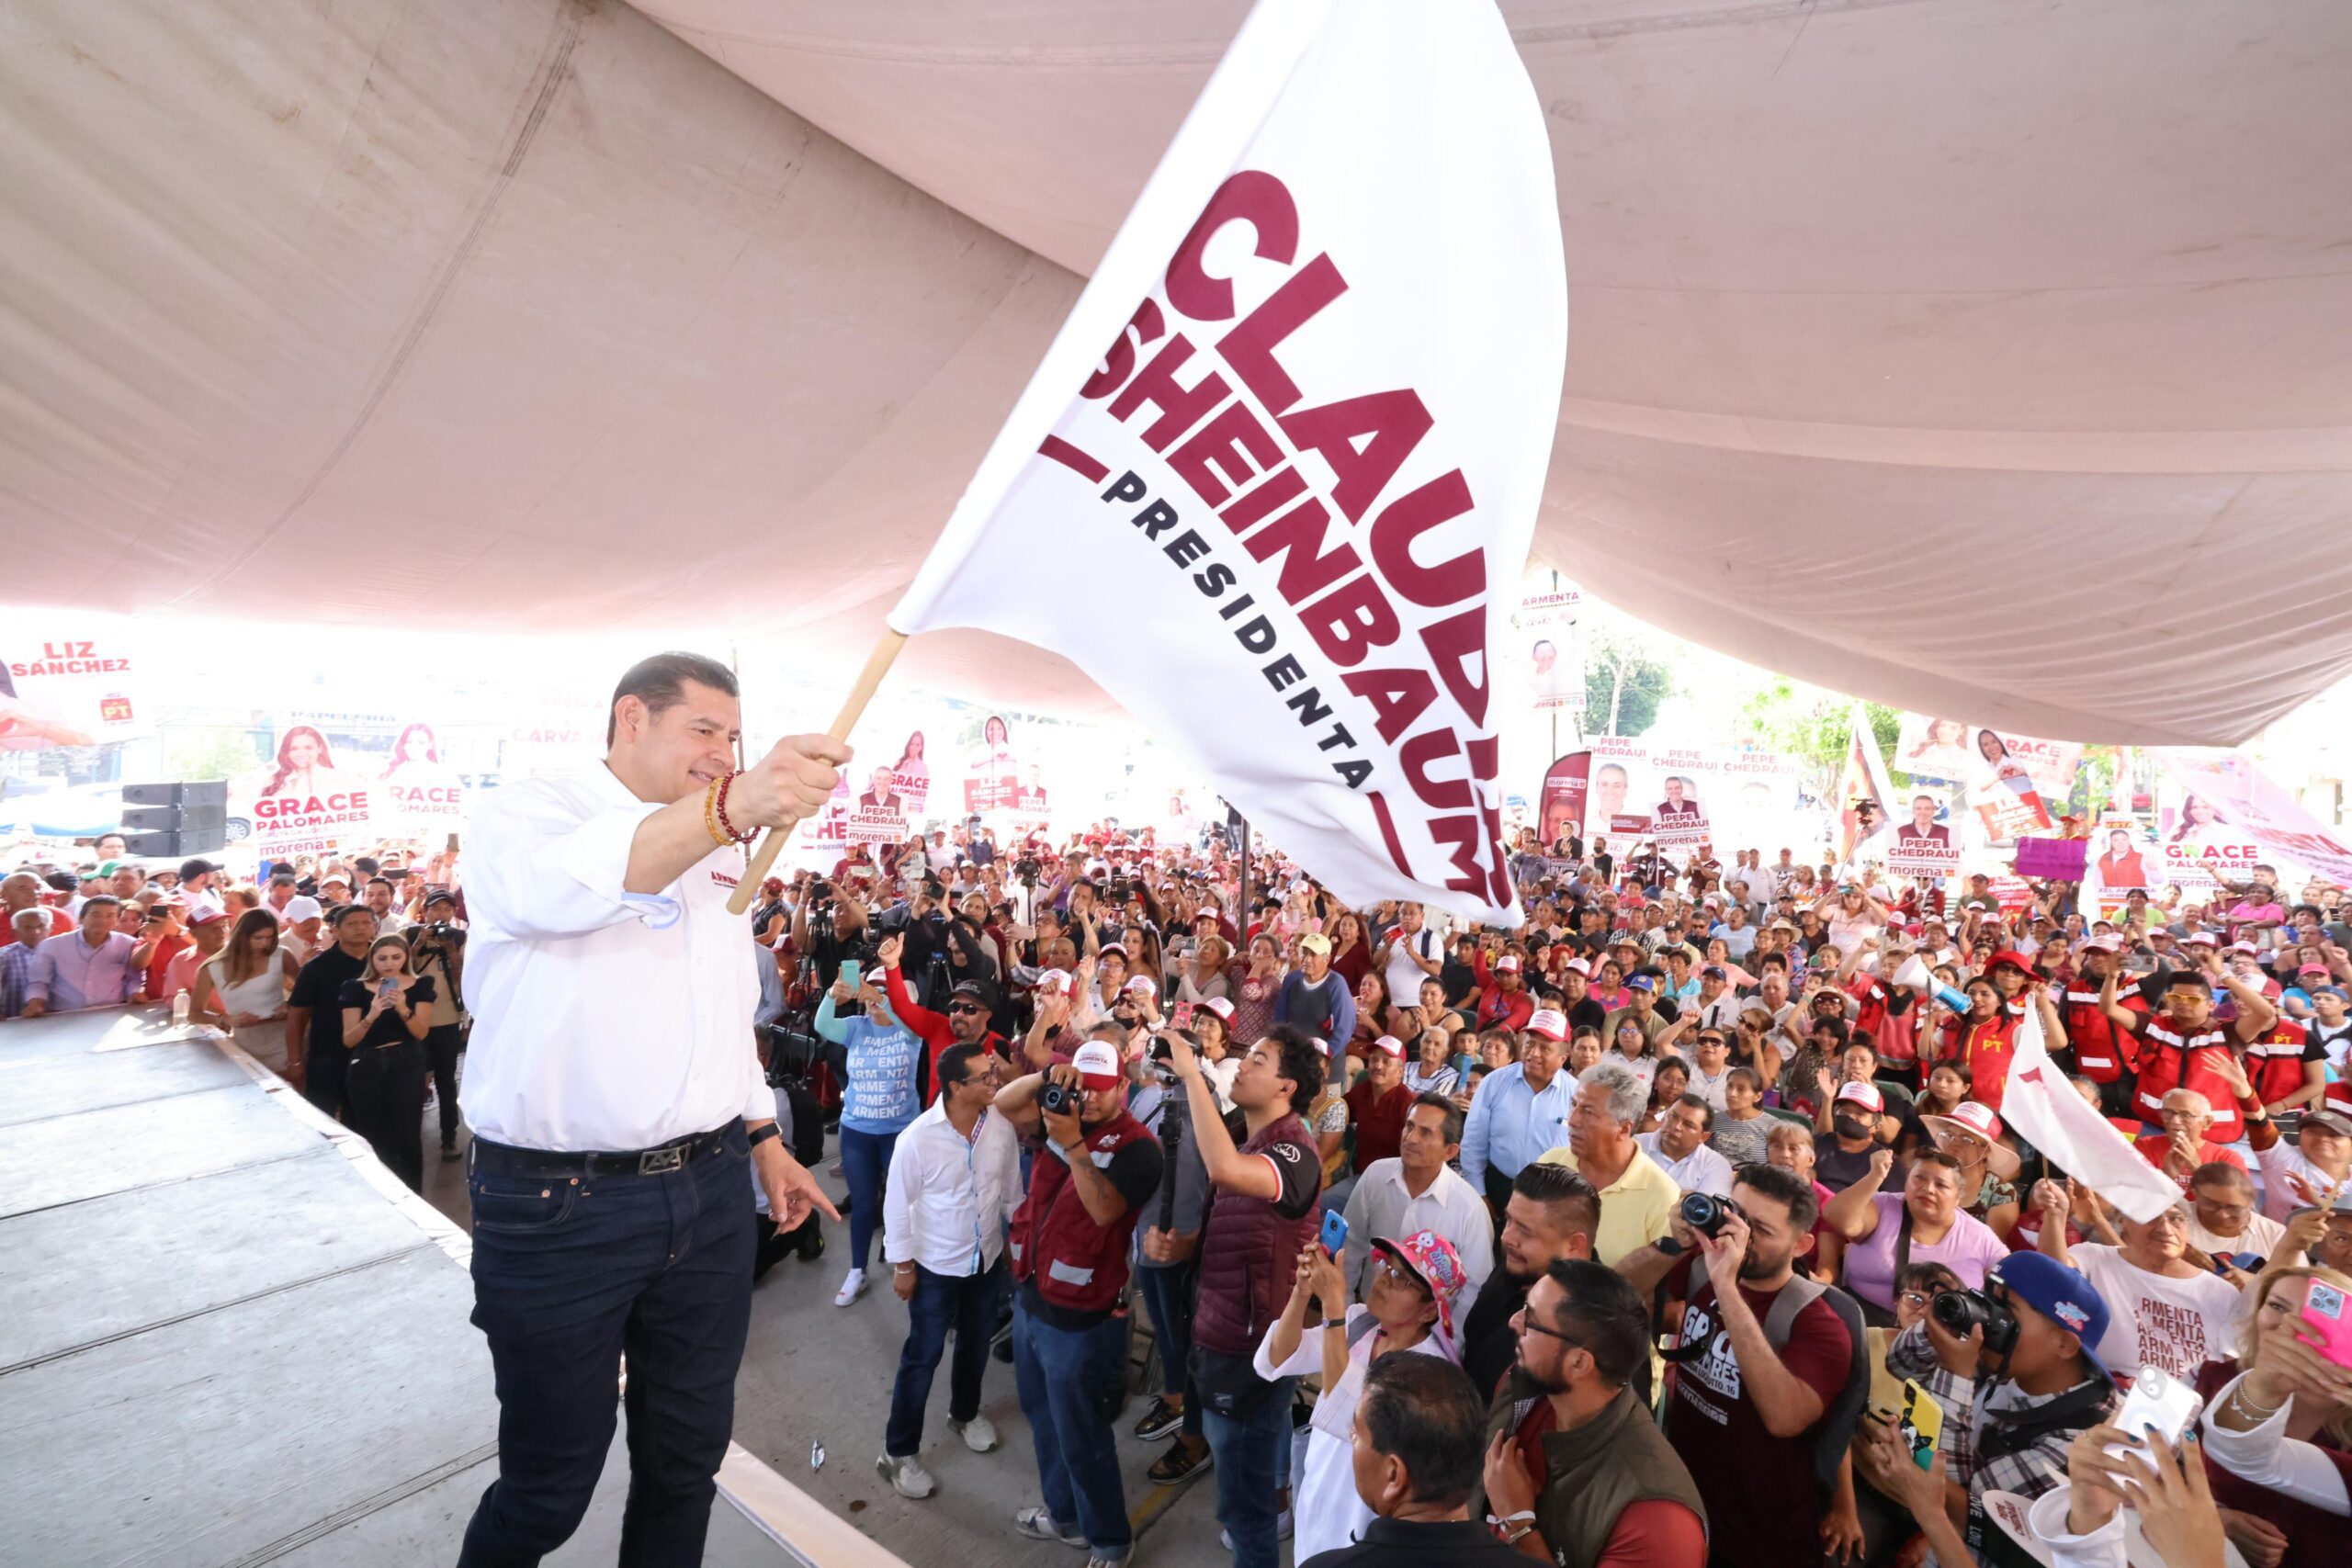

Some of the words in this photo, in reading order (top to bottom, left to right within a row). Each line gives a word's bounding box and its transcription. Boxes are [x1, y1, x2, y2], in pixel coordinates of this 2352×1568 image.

[1079, 297, 1493, 907] SHEINBAUM
[1521, 592, 1579, 606] ARMENTA
[1102, 469, 1374, 789] PRESIDENTA
[43, 641, 96, 660] LIZ
[10, 658, 130, 677] SÁNCHEZ
[103, 705, 128, 718] PT
[513, 728, 606, 744] CARVAJA
[1600, 738, 1631, 747] PEPE
[2006, 739, 2061, 757] RACE
[1585, 746, 1646, 757] CHEDRAUI
[1668, 750, 1702, 760] PEPE
[1652, 758, 1718, 770] CHEDRAUI
[1742, 754, 1777, 763] PEPE
[387, 785, 461, 803] RACE
[889, 787, 927, 797] ALOMARES
[254, 791, 368, 818] GRACE
[865, 807, 894, 816] PEPE
[256, 811, 369, 831] PALOMARES
[850, 815, 906, 826] CHEDRAUI
[1666, 814, 1693, 822] PEPE
[1654, 819, 1709, 830] CHEDRAUI
[849, 833, 892, 843] morena
[1657, 836, 1700, 846] morena
[1905, 839, 1940, 848] PEPE
[259, 840, 325, 855] morena
[1888, 847, 1960, 859] CHEDRAUI
[2165, 843, 2258, 859] GACE
[1889, 865, 1942, 877] morena
[2169, 879, 2222, 888] morena
[2274, 1035, 2292, 1044] PT
[1983, 1039, 2004, 1053] PT
[877, 1055, 910, 1067] ENTA
[2142, 1297, 2203, 1327] RMENTA
[2153, 1315, 2206, 1343] MENTA
[2139, 1335, 2174, 1357] ARM
[2139, 1349, 2186, 1375] ARME
[1726, 1384, 1736, 1395] 16
